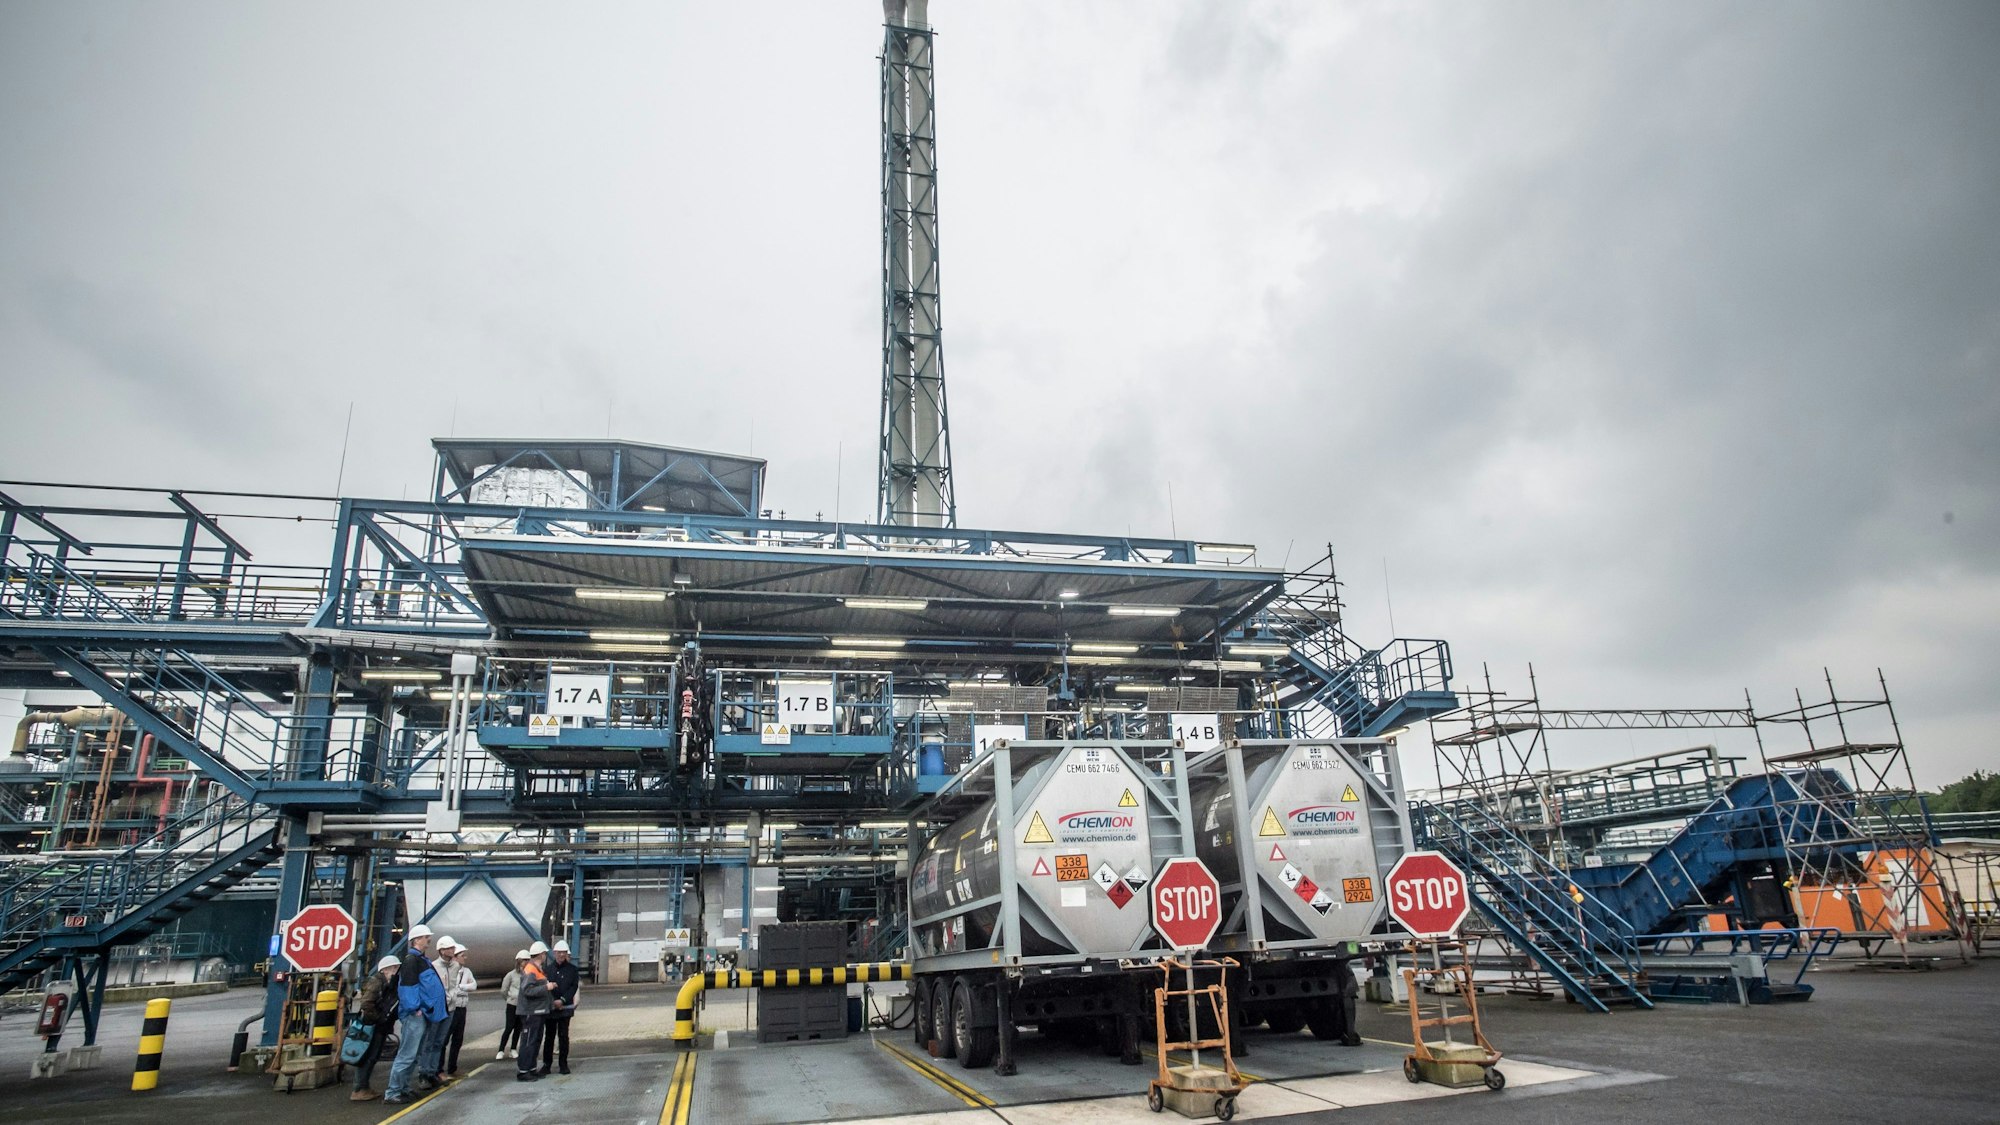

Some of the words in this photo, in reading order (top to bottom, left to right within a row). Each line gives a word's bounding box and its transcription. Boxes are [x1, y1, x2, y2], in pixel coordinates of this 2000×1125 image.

[555, 688, 582, 703] 1.7
[586, 688, 602, 704] A
[783, 697, 809, 712] 1.7
[816, 697, 828, 712] B
[1176, 726, 1199, 740] 1.4
[1203, 726, 1215, 740] B
[1066, 764, 1086, 773] CEMU
[1088, 764, 1100, 773] 662
[1102, 763, 1120, 773] 7466
[1292, 761, 1311, 770] CEMU
[1311, 760, 1323, 769] 662
[1068, 816, 1134, 829] CHEMION
[1297, 811, 1355, 823] CHEMION
[1292, 827, 1359, 836] www.chemion.de
[1062, 834, 1136, 843] www.chemion.de
[1062, 856, 1082, 867] 338
[1060, 869, 1086, 880] 2924
[1349, 880, 1366, 889] 338
[1347, 890, 1370, 901] 2924
[1394, 876, 1459, 912] STOP
[1160, 885, 1213, 922] STOP
[290, 925, 349, 952] STOP
